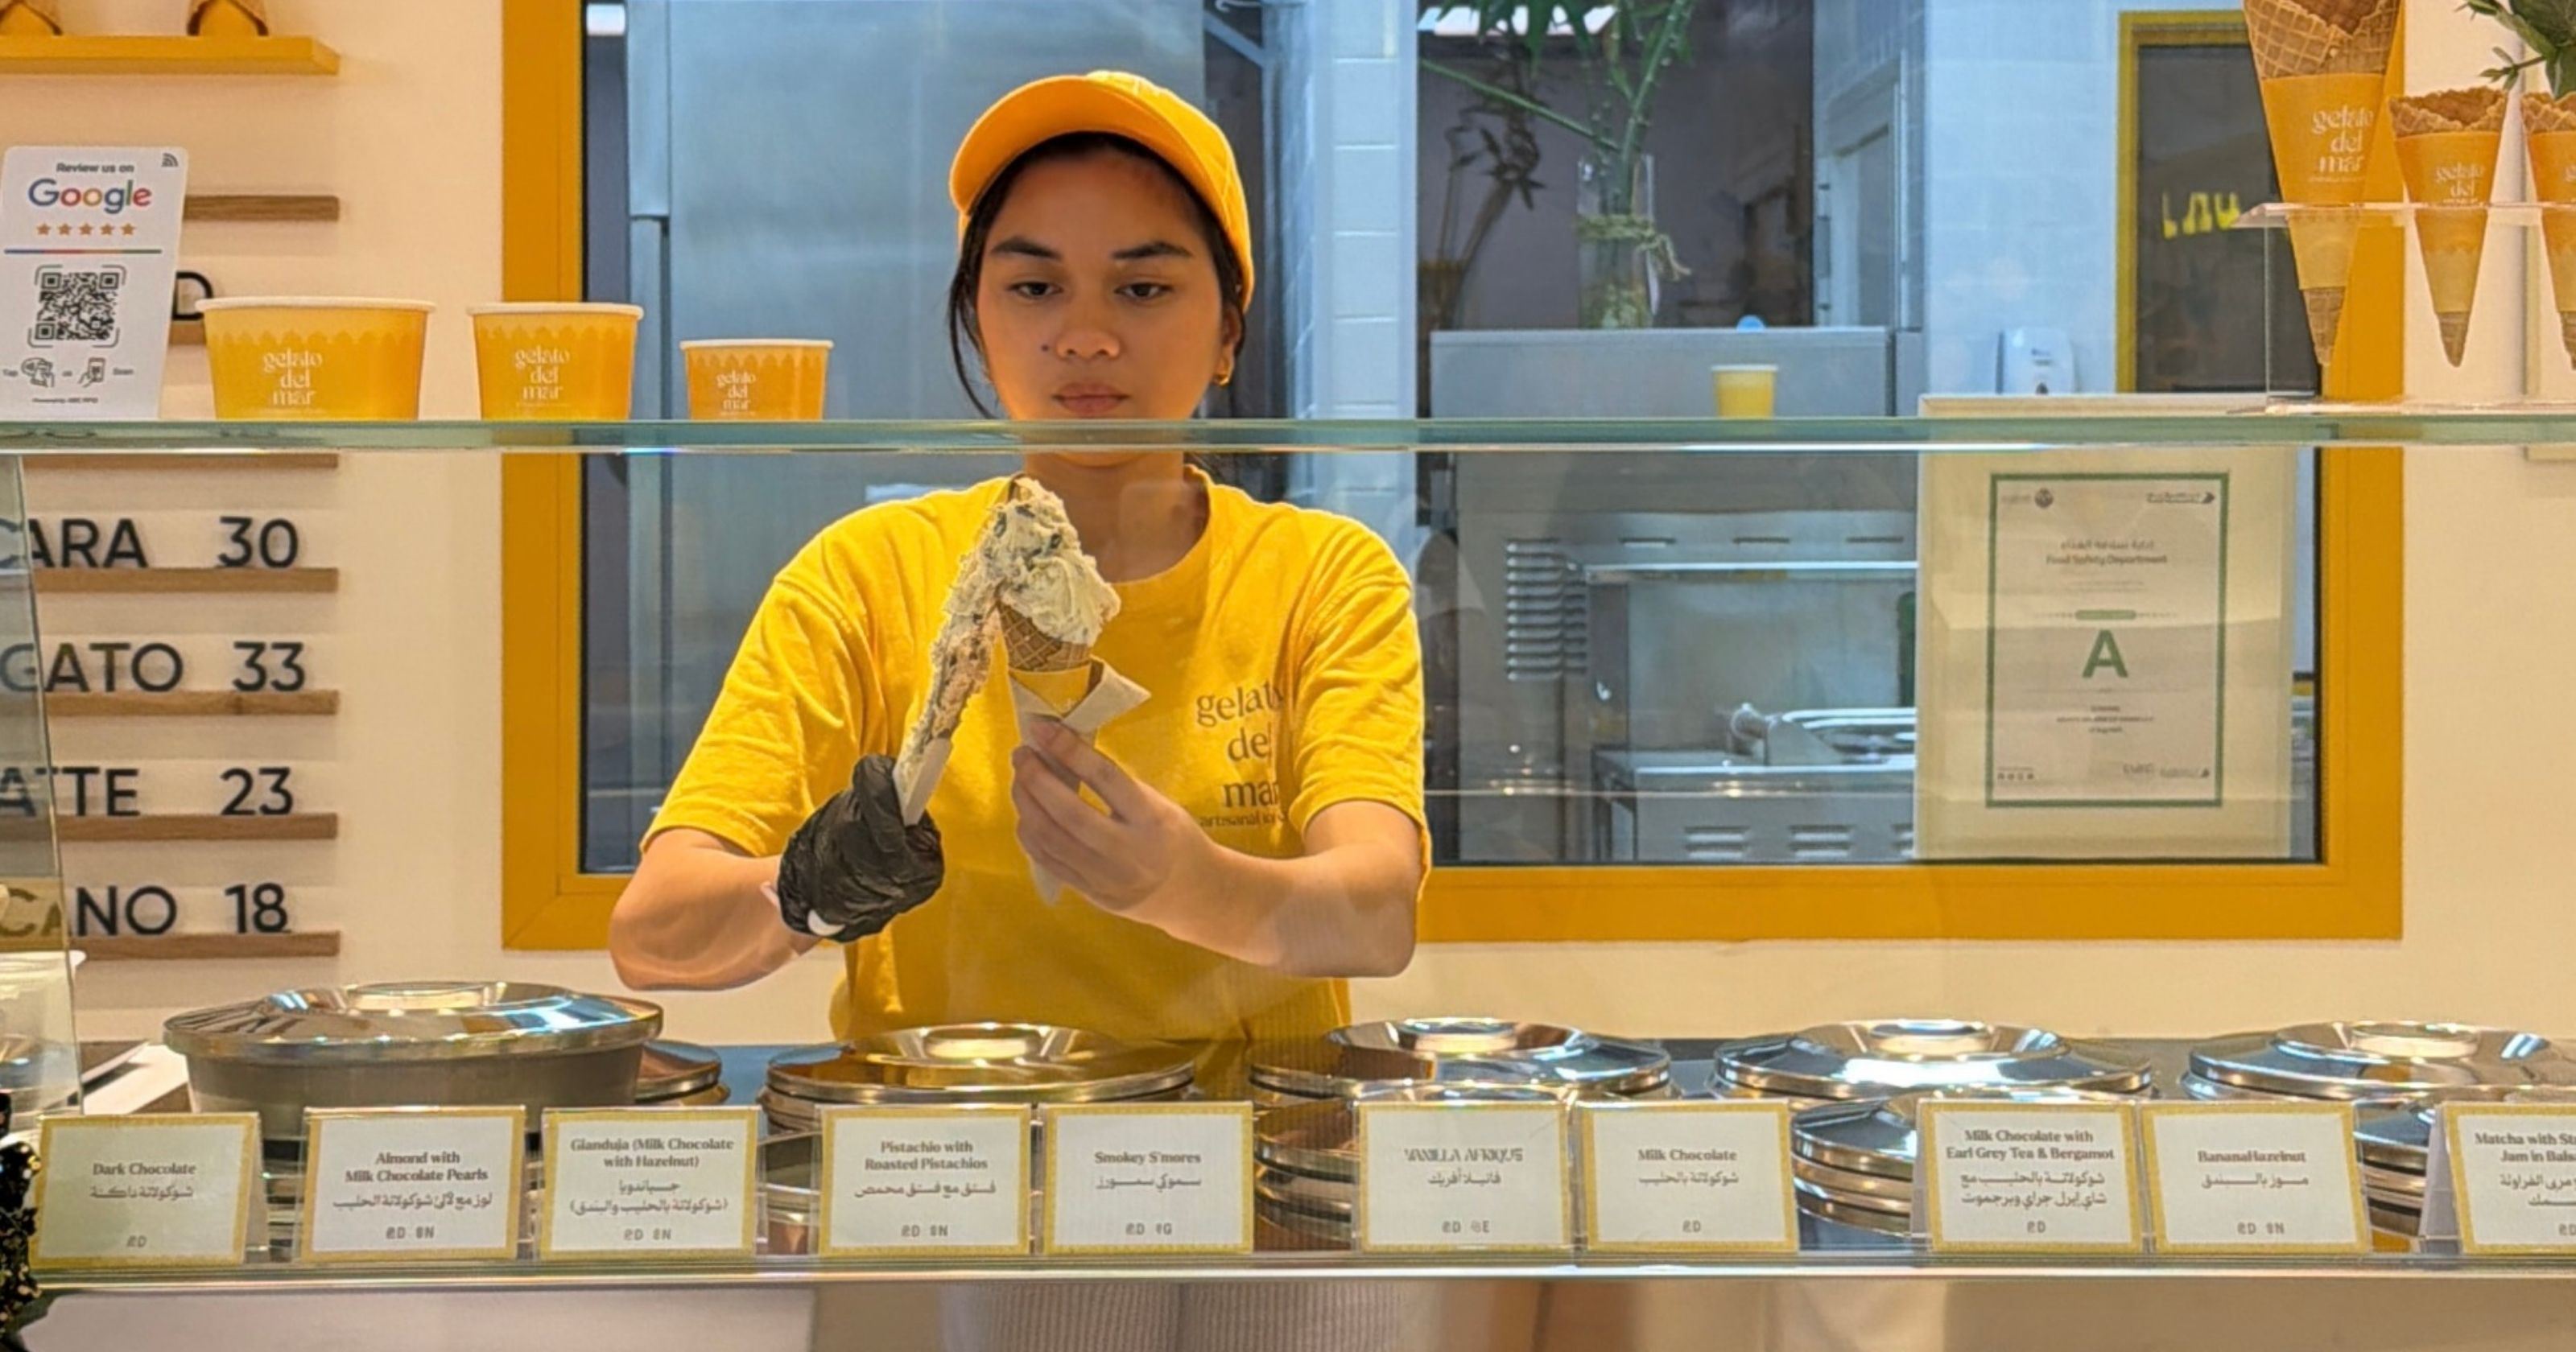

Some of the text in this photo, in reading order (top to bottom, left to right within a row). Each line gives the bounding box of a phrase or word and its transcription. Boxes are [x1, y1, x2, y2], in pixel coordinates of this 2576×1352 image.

[2312, 105, 2375, 135] gelato
[2330, 130, 2363, 153] del
[56, 163, 134, 173] Review us on
[28, 179, 152, 214] Google
[262, 348, 323, 373] gelato
[514, 344, 571, 372] gelato
[279, 368, 310, 388] del
[530, 365, 559, 384] del
[716, 369, 757, 389] gelato
[727, 385, 748, 399] del
[217, 516, 299, 568] 30
[2082, 629, 2129, 678] A
[0, 641, 306, 693] GATO 33
[220, 767, 294, 817] 23
[225, 883, 291, 934] 18
[1964, 1129, 2093, 1143] Milk Chocolate with
[2475, 1132, 2525, 1144] Matcha
[2527, 1132, 2557, 1144] with
[570, 1137, 734, 1152] Gianduja (Milk Chocolate
[881, 1140, 973, 1153] Pistachio with
[375, 1151, 460, 1164] Almond with
[1094, 1151, 1201, 1164] Smokey S'mores
[1637, 1148, 1737, 1161] Milk Chocolate
[1946, 1147, 2115, 1161] Earl Grey Tea & Bergamot
[2500, 1150, 2529, 1163] Jam
[2531, 1149, 2544, 1162] in
[604, 1155, 700, 1168] with Hazelnut)
[865, 1157, 988, 1170] Roasted Pistachios
[93, 1162, 196, 1176] Dark Chocolate
[345, 1169, 489, 1182] Milk Chocolate Pearls
